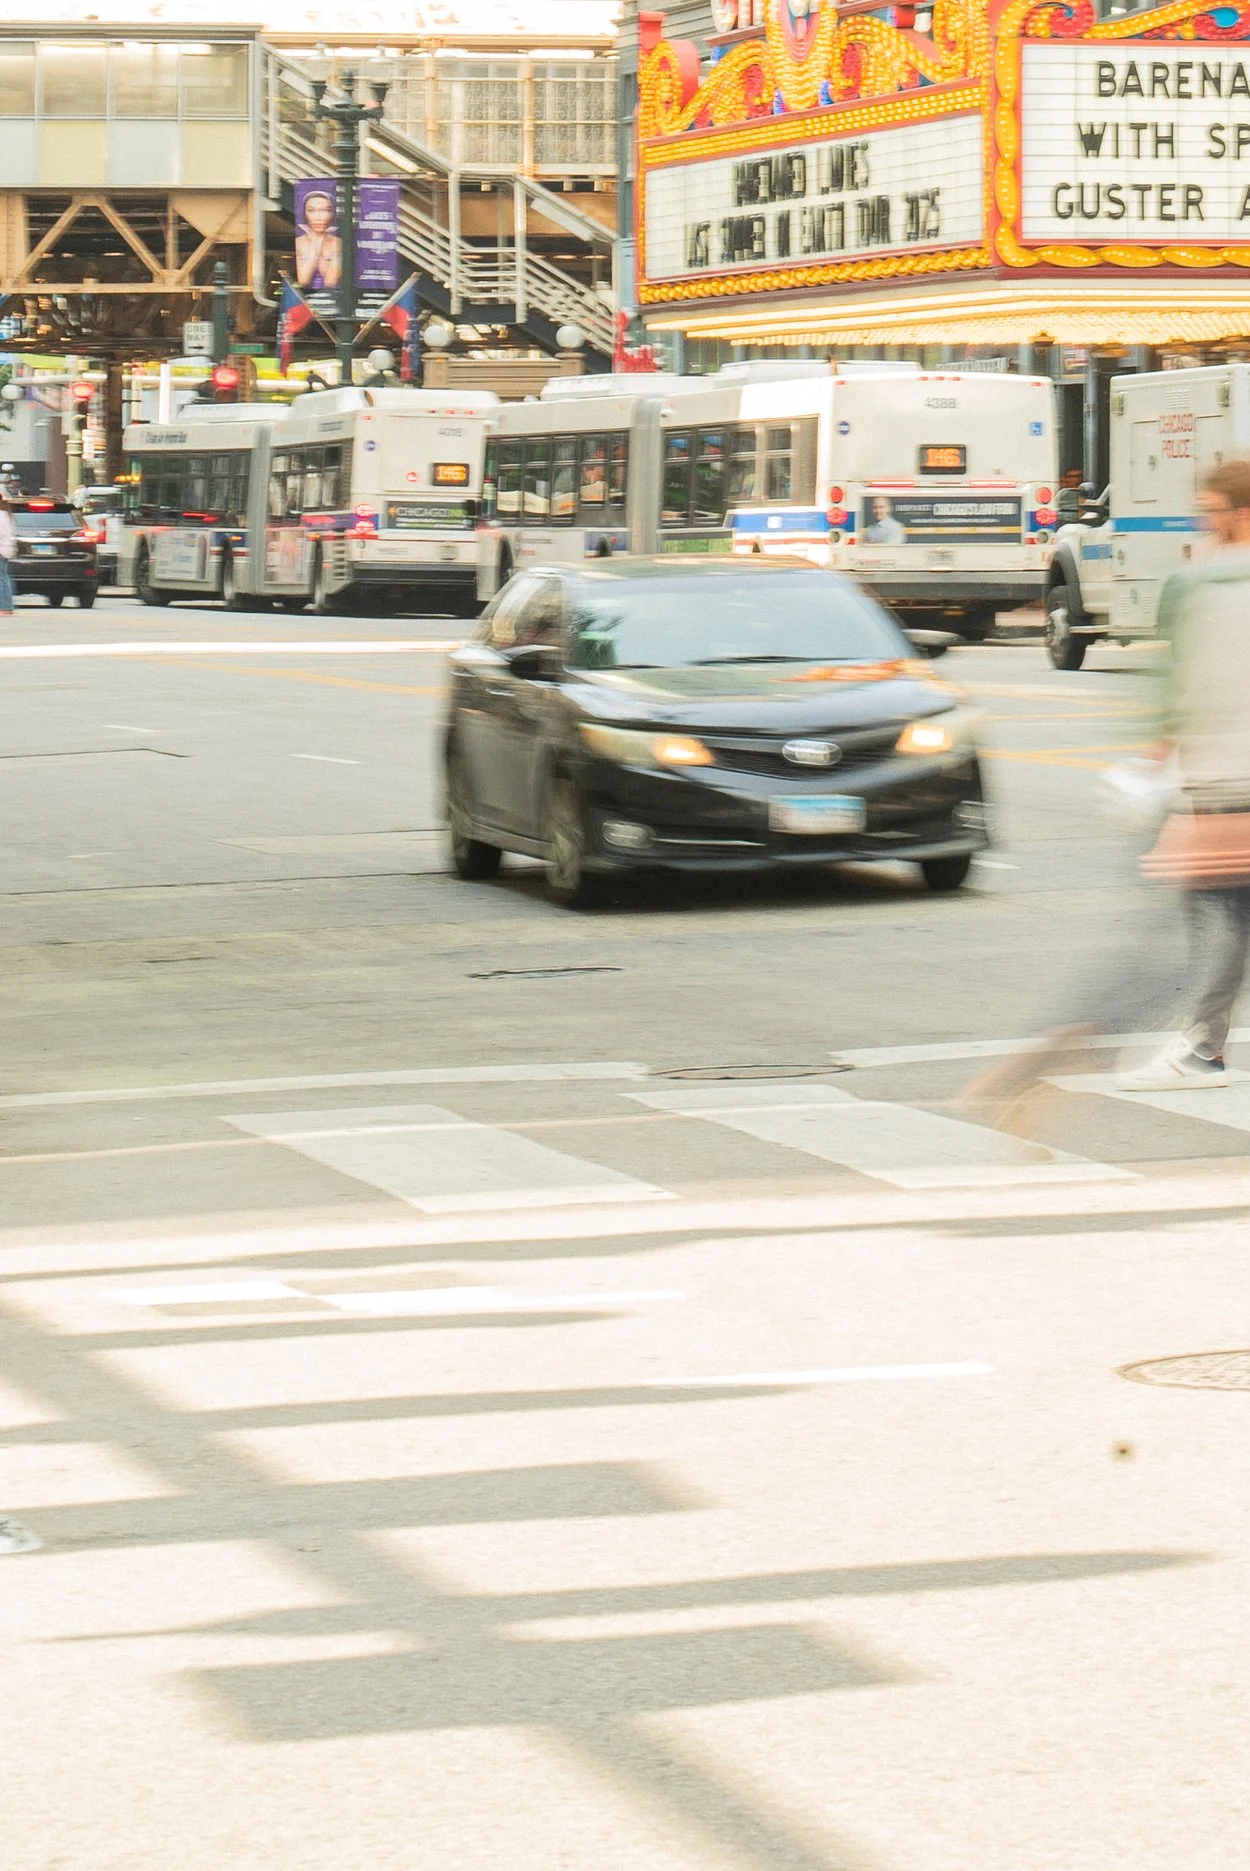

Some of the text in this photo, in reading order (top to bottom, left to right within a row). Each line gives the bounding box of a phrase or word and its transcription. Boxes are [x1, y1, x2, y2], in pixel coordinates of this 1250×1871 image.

[1077, 121, 1175, 160] WITH
[1053, 182, 1205, 221] GUSTER
[1158, 412, 1194, 433] CHICAGO
[1161, 438, 1193, 458] POLICE
